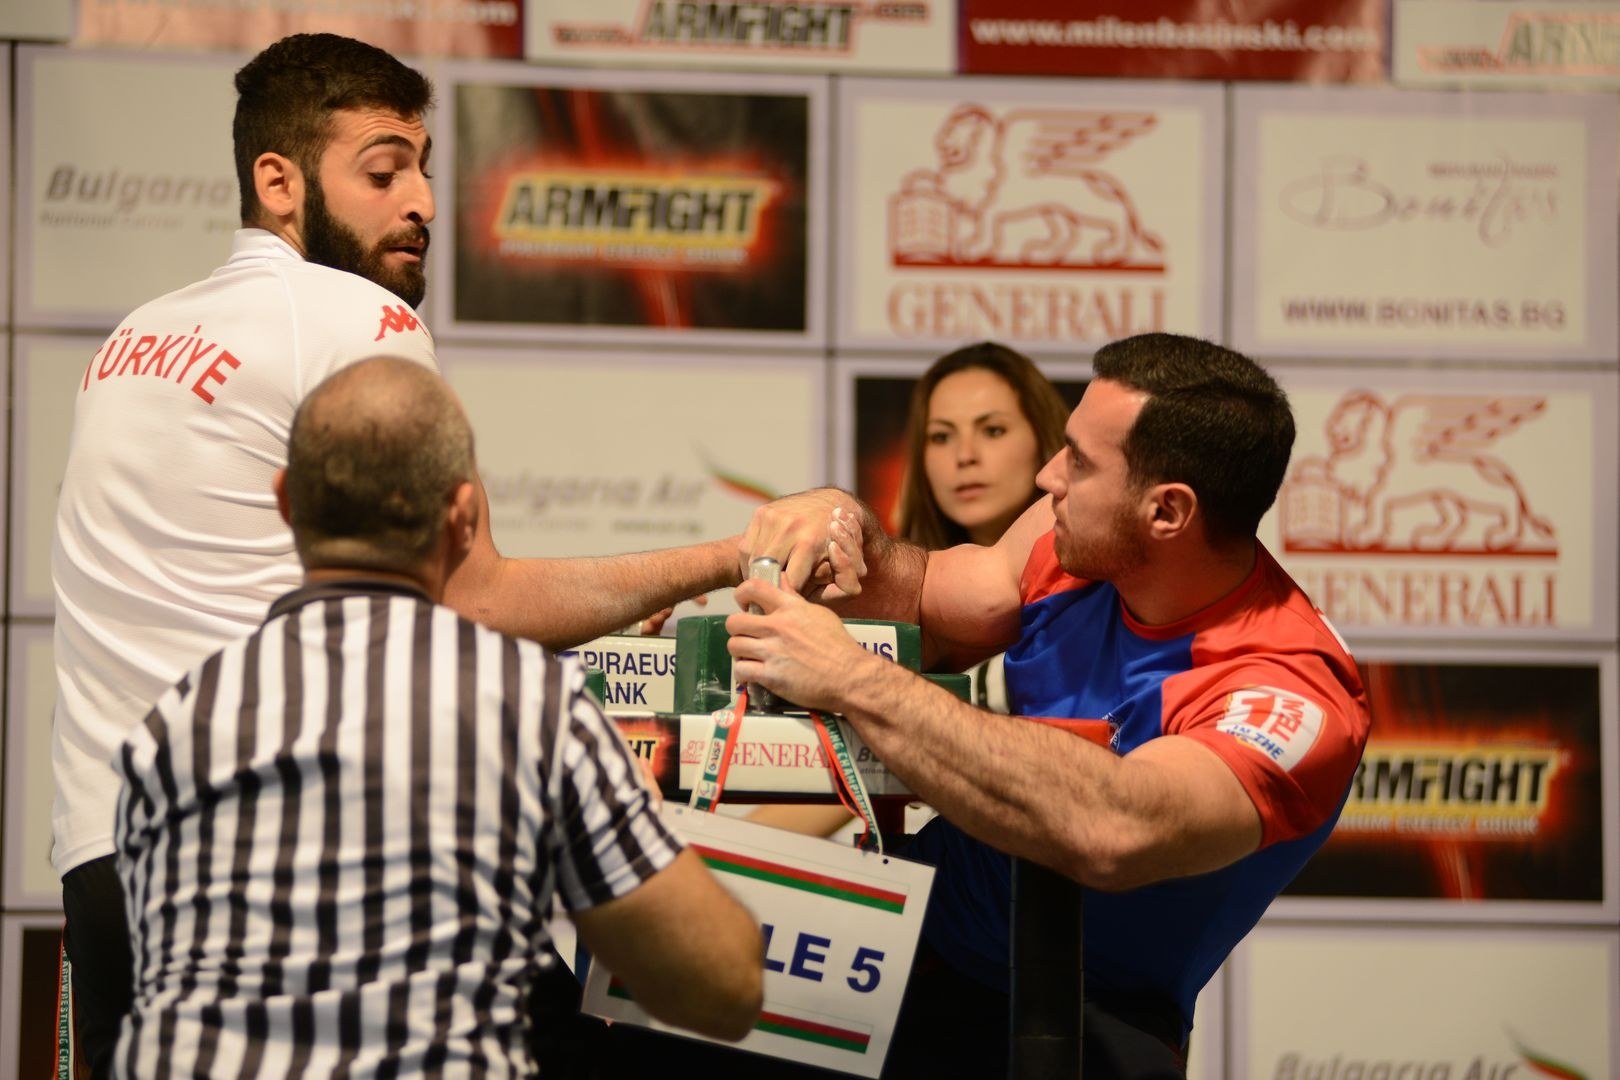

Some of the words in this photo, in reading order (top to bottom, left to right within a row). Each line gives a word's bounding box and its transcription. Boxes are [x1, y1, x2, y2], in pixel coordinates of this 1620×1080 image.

[643, 0, 854, 50] ARMFIGHT
[506, 183, 757, 234] ARMFIGHT
[886, 280, 1167, 339] GENERALI
[483, 470, 642, 514] ulgaria
[605, 682, 648, 705] ANK
[728, 741, 831, 769] GENERA
[1254, 732, 1285, 760] THE
[1350, 758, 1550, 804] RMFIGHT
[761, 922, 832, 983] LE
[846, 946, 886, 994] 5
